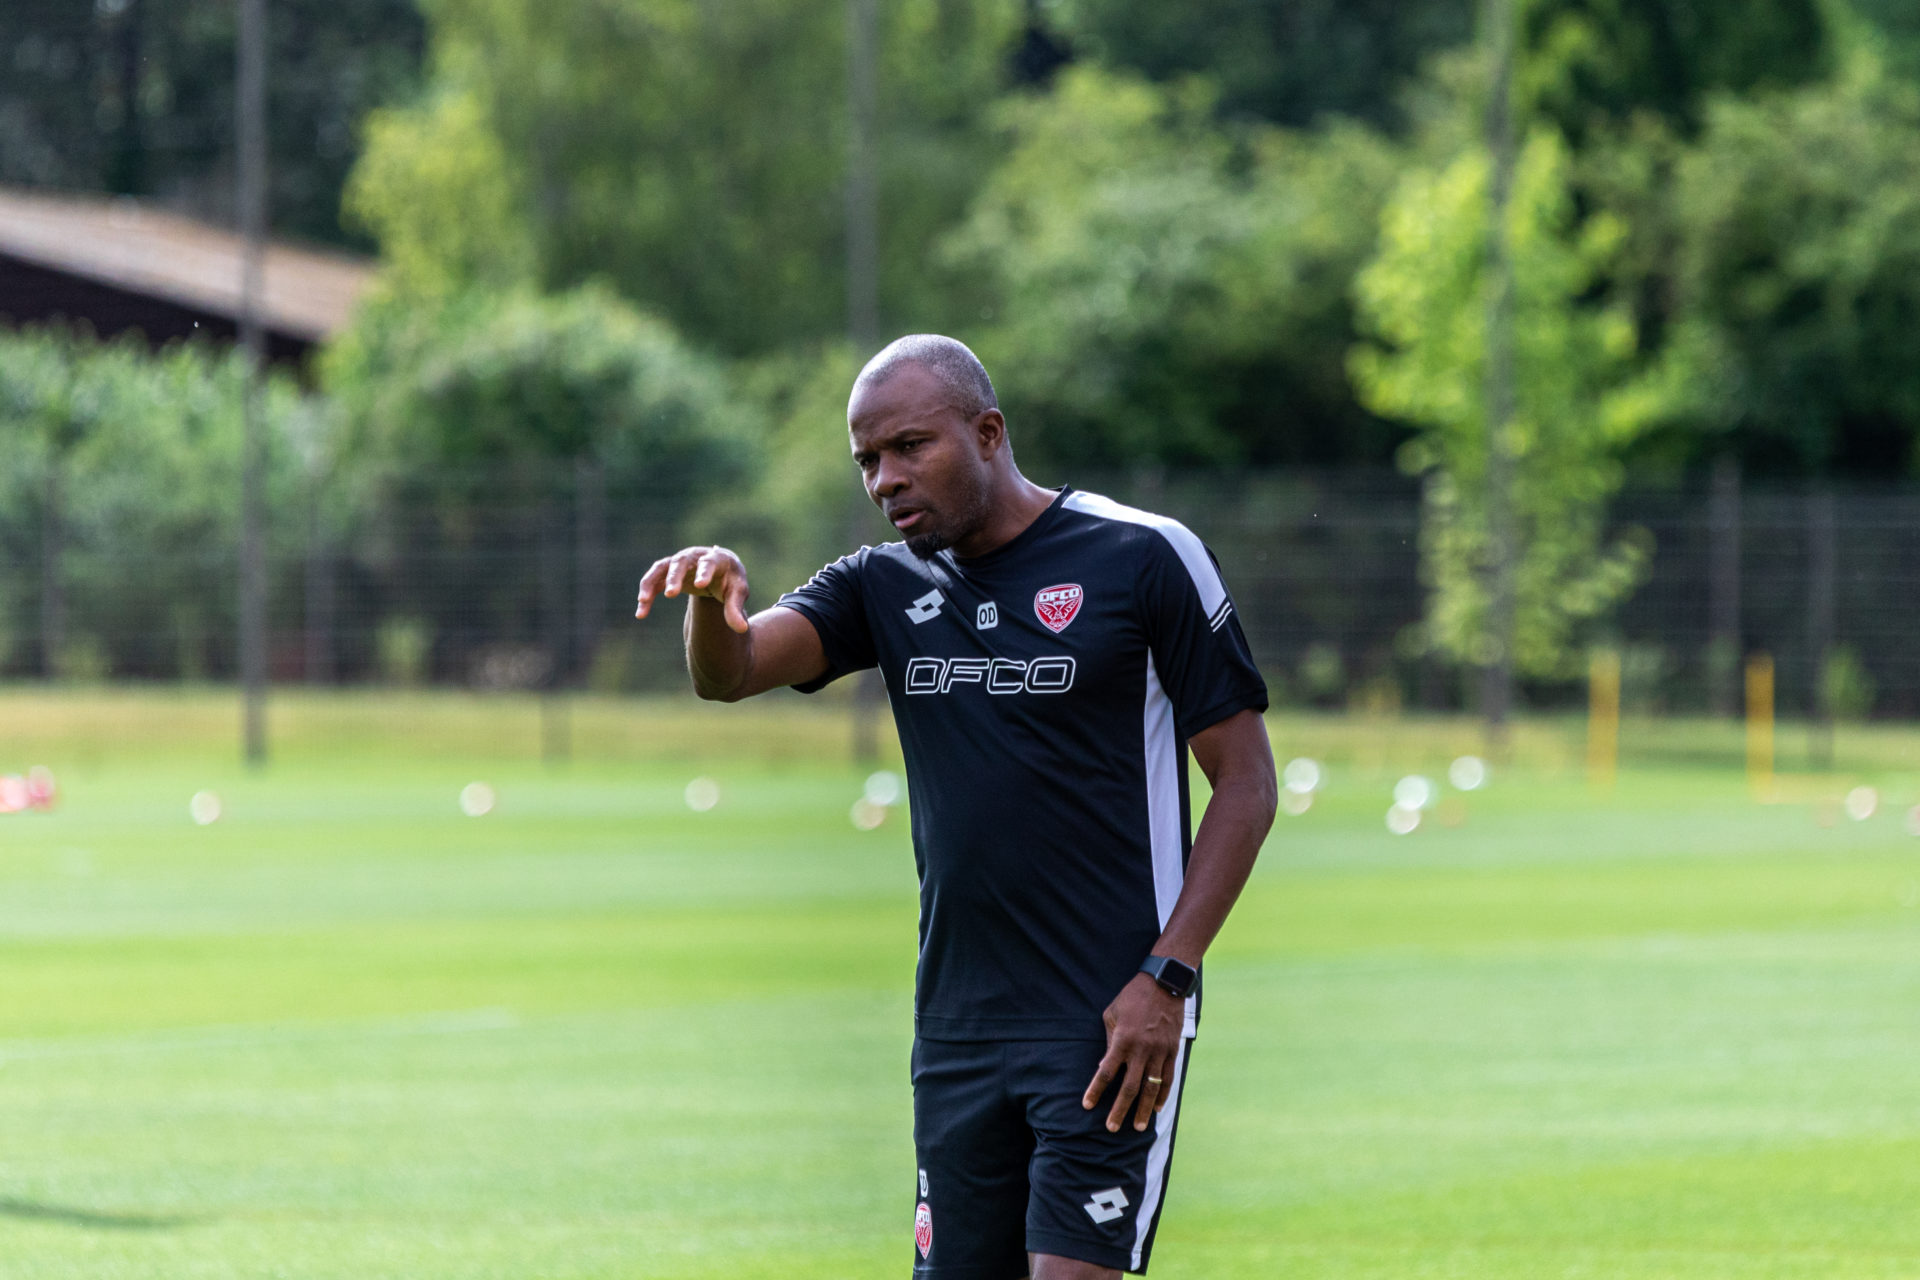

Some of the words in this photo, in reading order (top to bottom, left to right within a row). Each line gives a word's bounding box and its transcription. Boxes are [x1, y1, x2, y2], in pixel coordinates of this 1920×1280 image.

[1039, 588, 1080, 602] DFCO
[979, 606, 996, 625] OD
[906, 656, 1076, 694] DFCO
